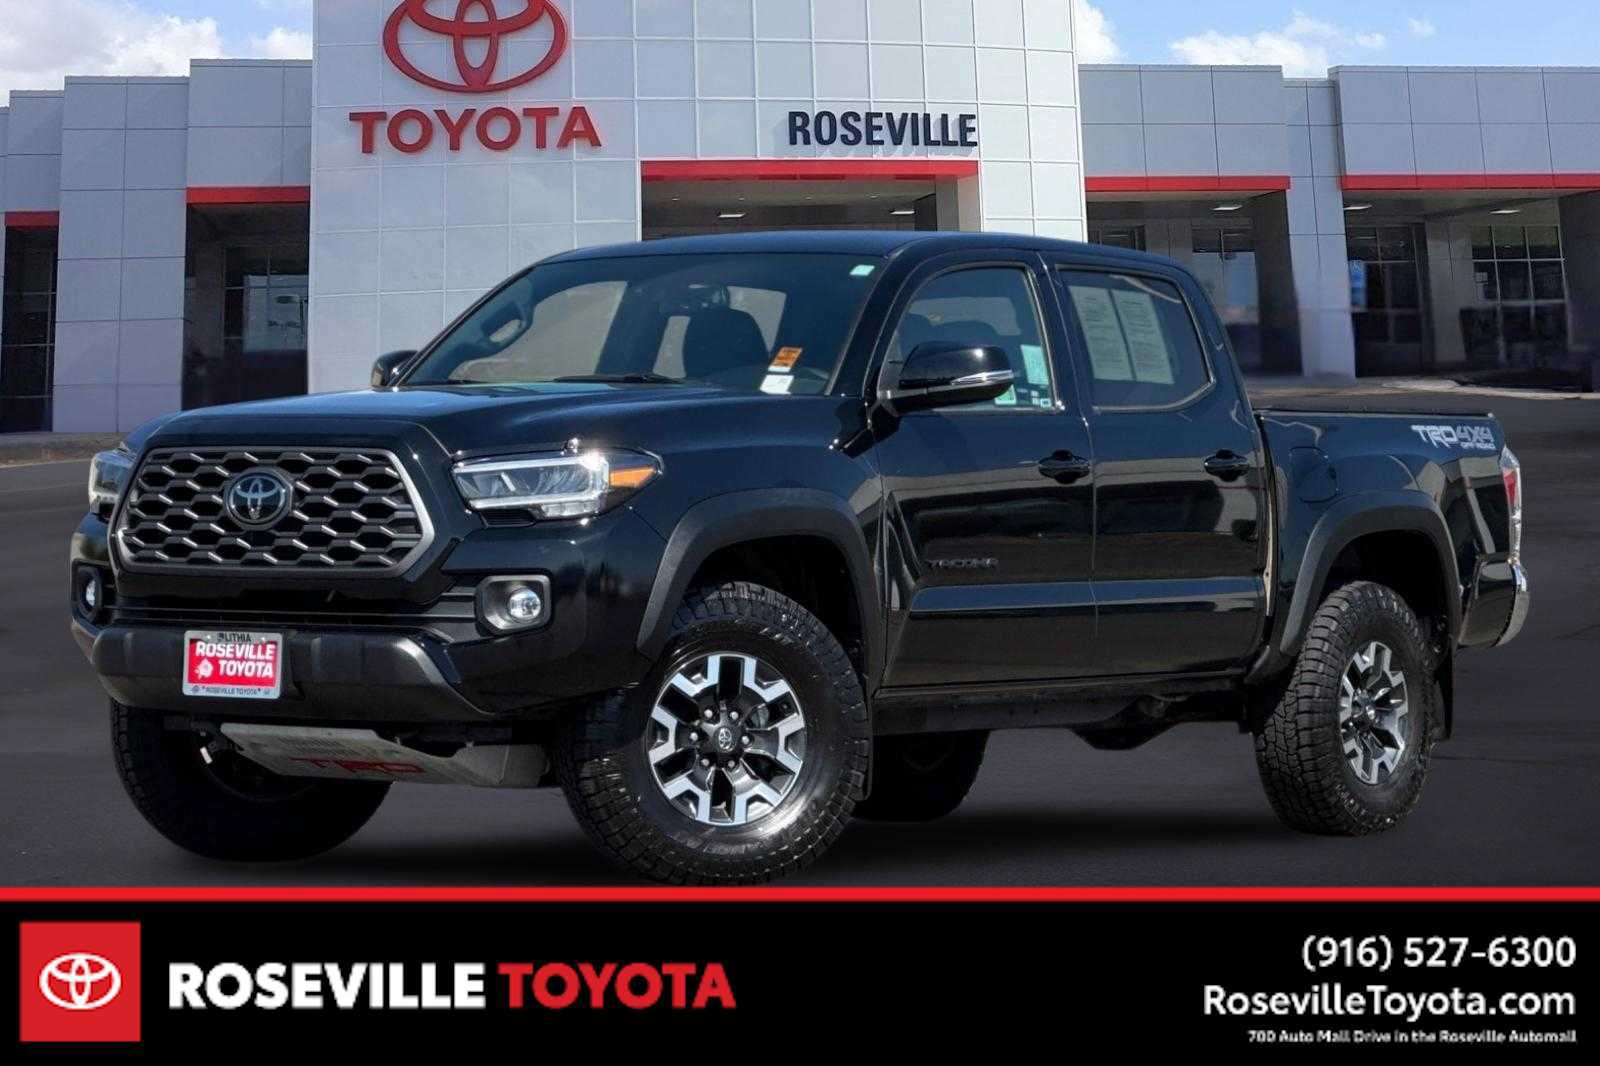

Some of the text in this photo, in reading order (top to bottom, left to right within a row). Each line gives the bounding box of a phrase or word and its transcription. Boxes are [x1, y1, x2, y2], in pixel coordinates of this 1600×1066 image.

[349, 106, 602, 153] TOYOTA
[788, 110, 978, 147] ROSEVILLE
[195, 641, 276, 660] ROSEVILLE
[218, 660, 274, 678] TOYOTA
